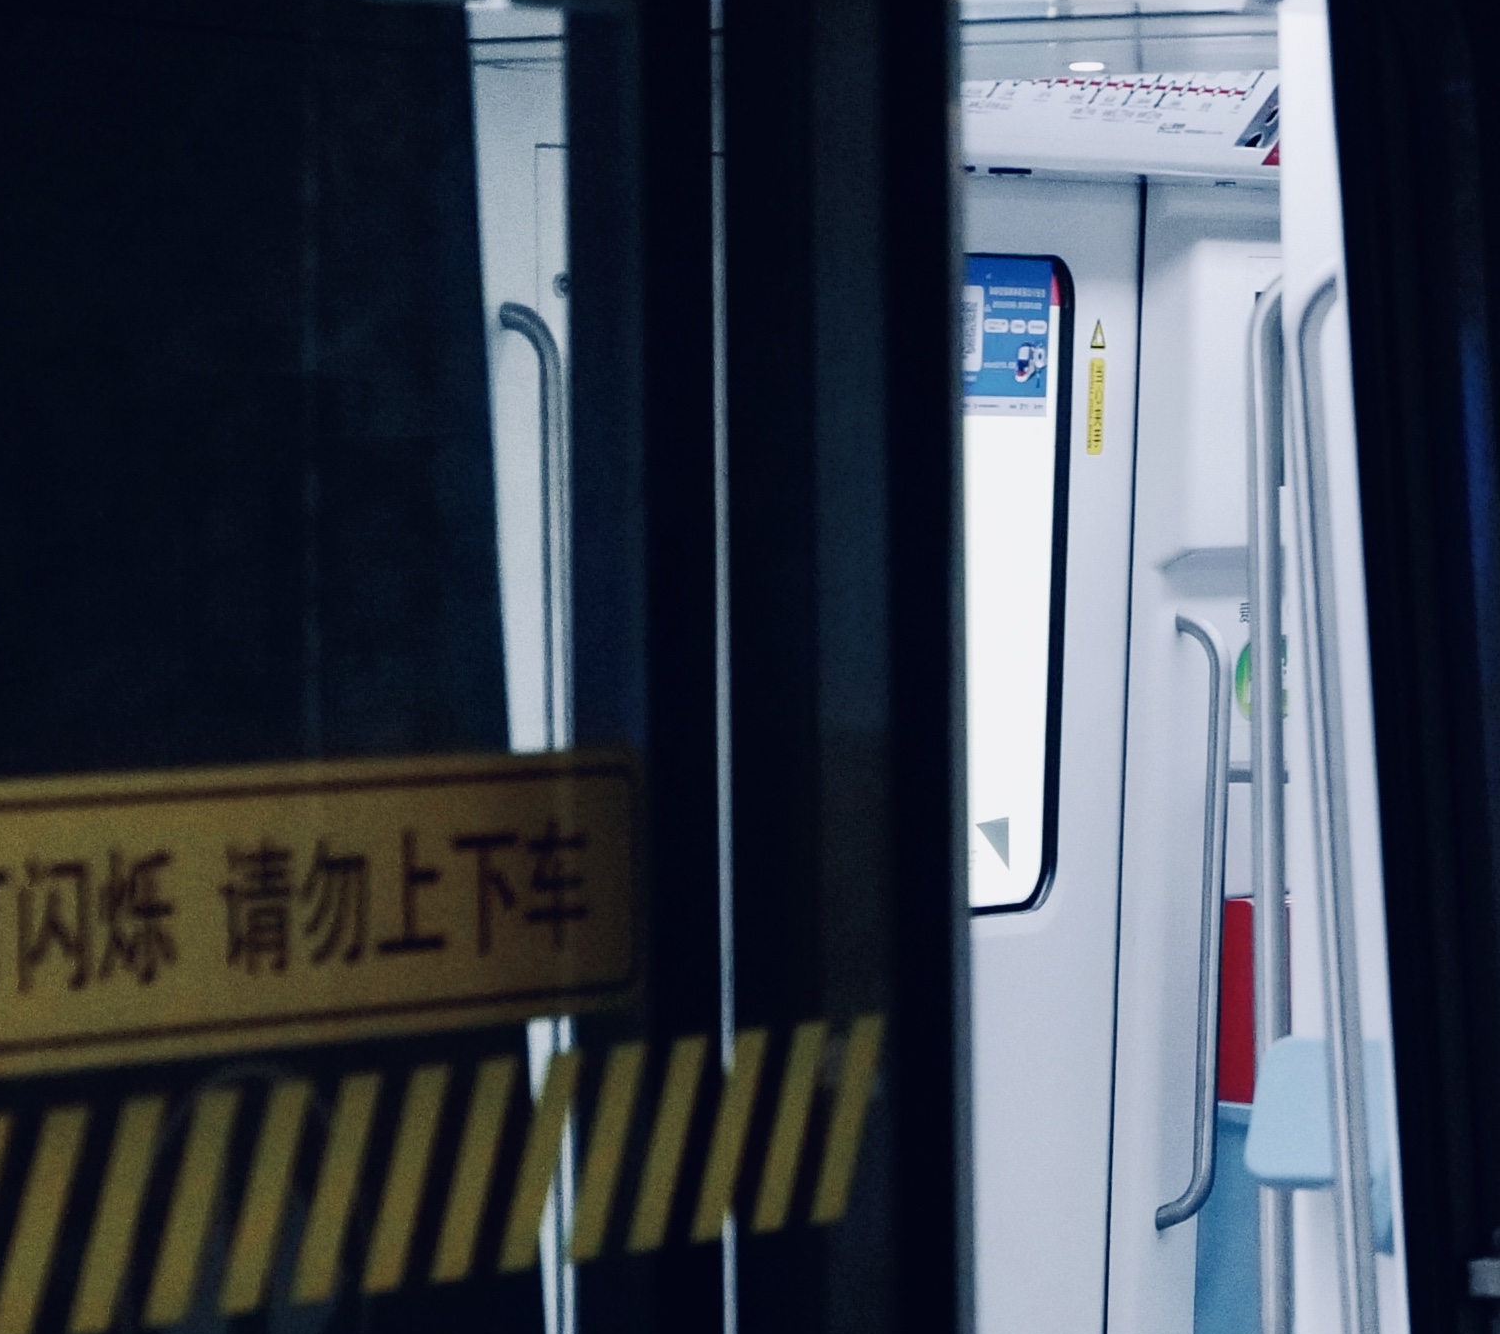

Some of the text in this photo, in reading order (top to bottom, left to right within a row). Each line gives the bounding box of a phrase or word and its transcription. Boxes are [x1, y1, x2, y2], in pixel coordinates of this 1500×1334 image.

[219, 819, 591, 977] 请勿上下车
